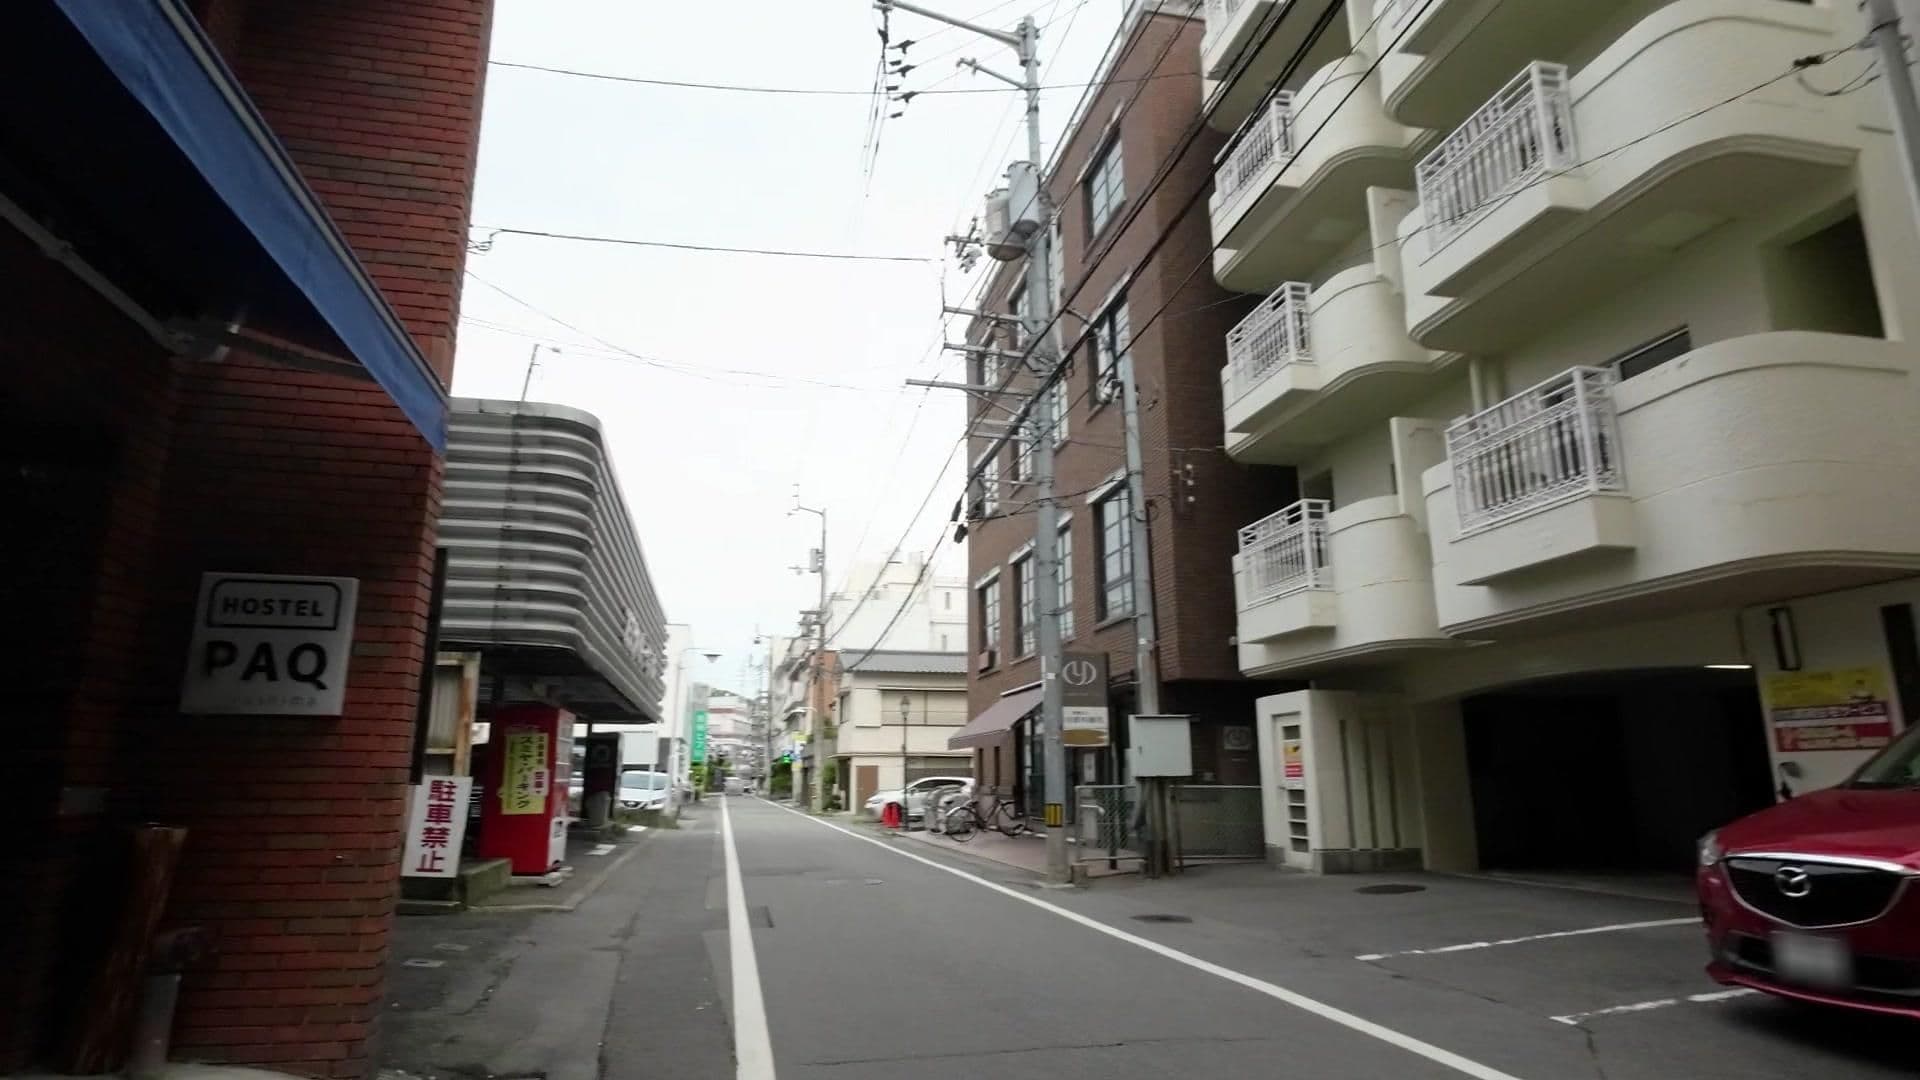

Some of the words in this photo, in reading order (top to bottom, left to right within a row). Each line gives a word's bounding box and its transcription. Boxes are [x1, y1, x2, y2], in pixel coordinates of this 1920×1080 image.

[222, 597, 324, 617] HOSTEL
[202, 639, 328, 691] PAQ
[415, 779, 458, 873] 駐車禁止
